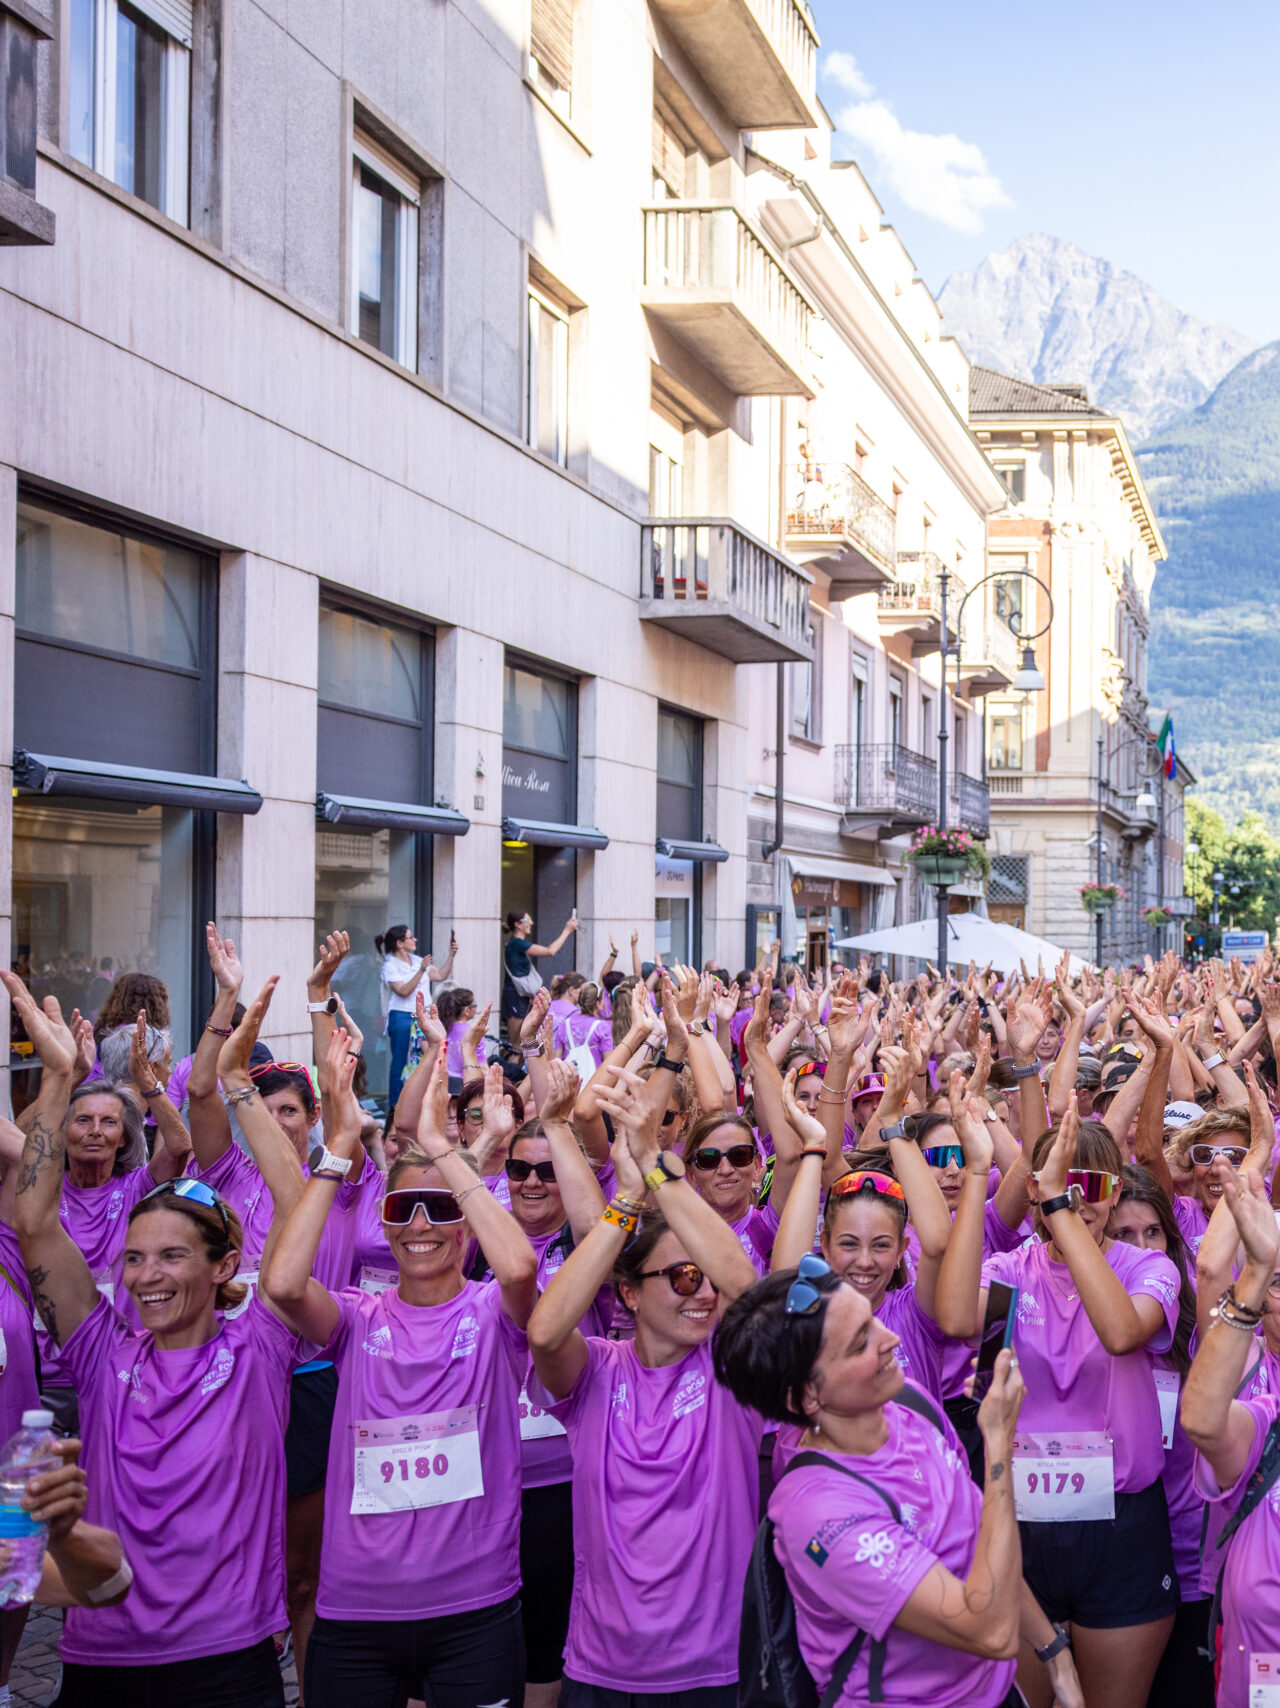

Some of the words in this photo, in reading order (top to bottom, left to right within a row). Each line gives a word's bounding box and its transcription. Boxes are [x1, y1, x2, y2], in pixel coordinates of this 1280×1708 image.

[524, 767, 550, 792] Rosa
[1026, 1316, 1046, 1327] PINK
[380, 1453, 449, 1484] 9180
[1027, 1472, 1085, 1494] 9179
